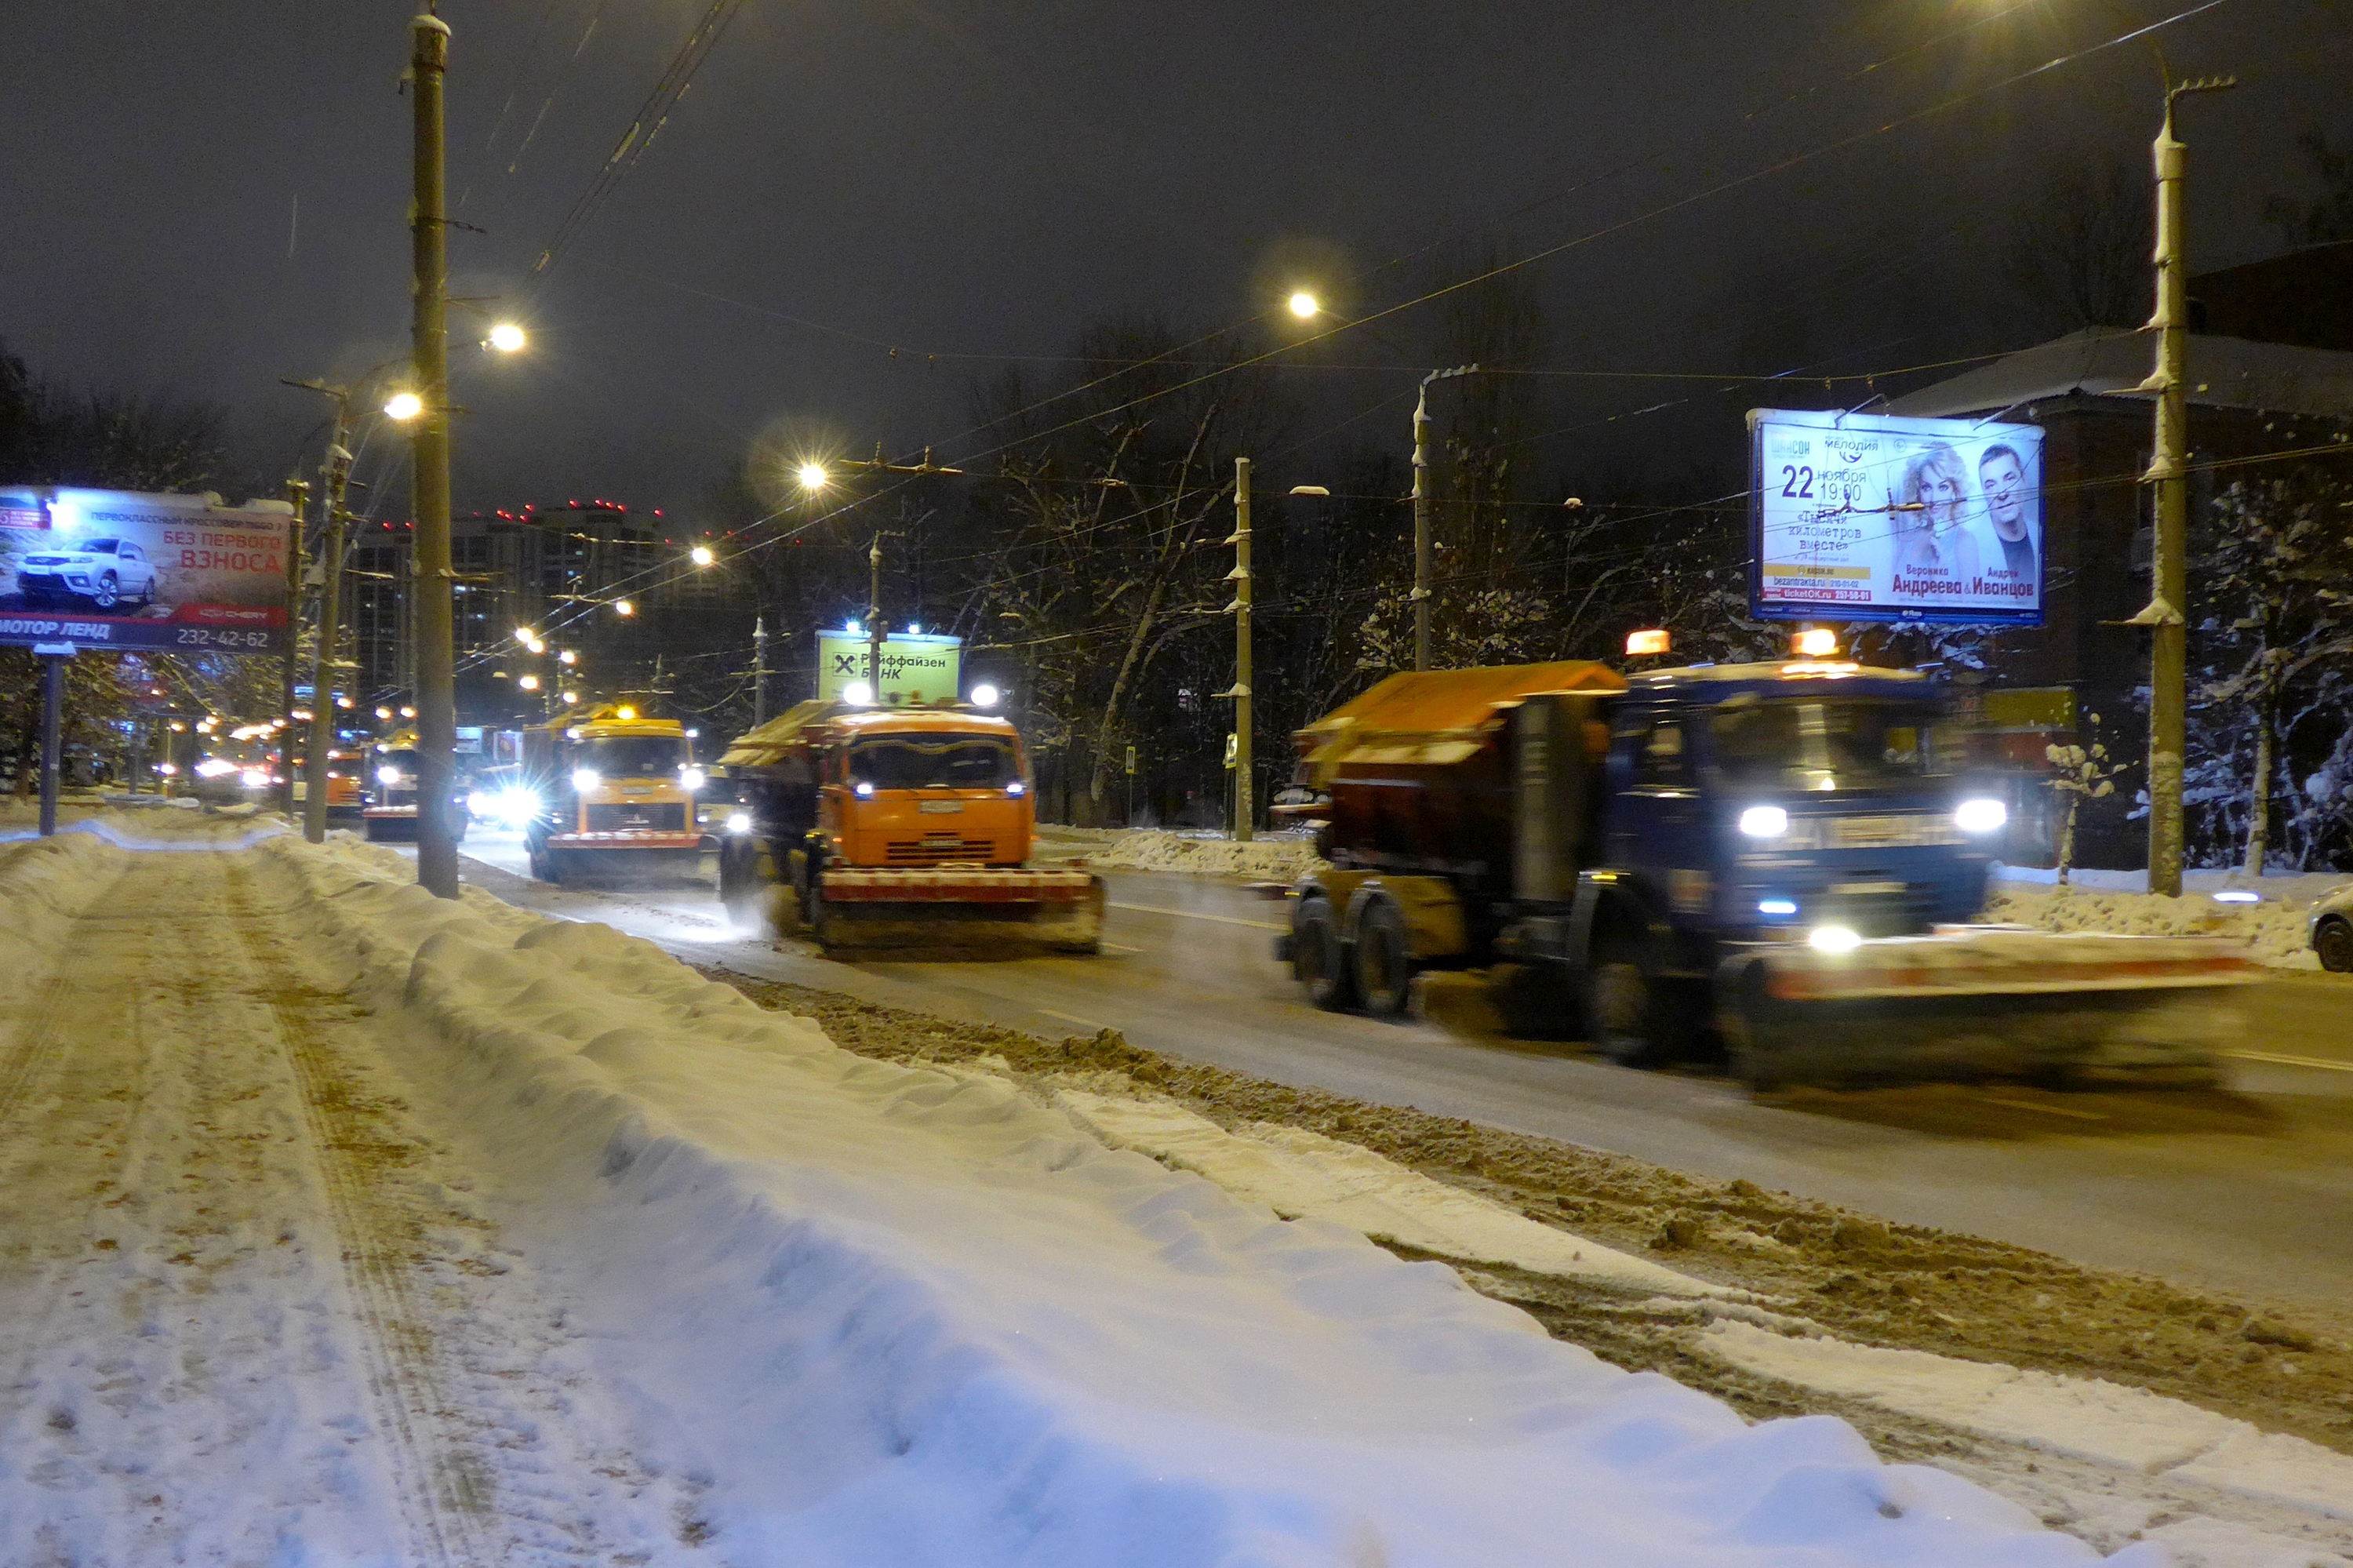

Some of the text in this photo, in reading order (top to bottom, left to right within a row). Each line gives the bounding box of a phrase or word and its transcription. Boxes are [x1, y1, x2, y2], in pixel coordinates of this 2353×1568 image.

[1824, 440, 1879, 452] МЕЛОДИЯ
[1782, 464, 1867, 498] 22 ноября
[1820, 482, 1862, 501] 19:00
[163, 530, 282, 550] БЕЗ ПЕРВОГО
[1788, 526, 1862, 540] километров
[1799, 540, 1849, 551] вместе»
[180, 549, 282, 573] ВЗНОСА
[1906, 564, 1949, 577] Вероника
[1784, 588, 1832, 599] ticketOK.ru
[1892, 574, 1962, 598] Андреева
[1973, 577, 2034, 598] Иванцов
[59, 622, 111, 640] ЛЕНД
[176, 628, 268, 648] 232-42-62
[860, 652, 946, 668] Рйффайзен
[860, 668, 902, 679] БНК
